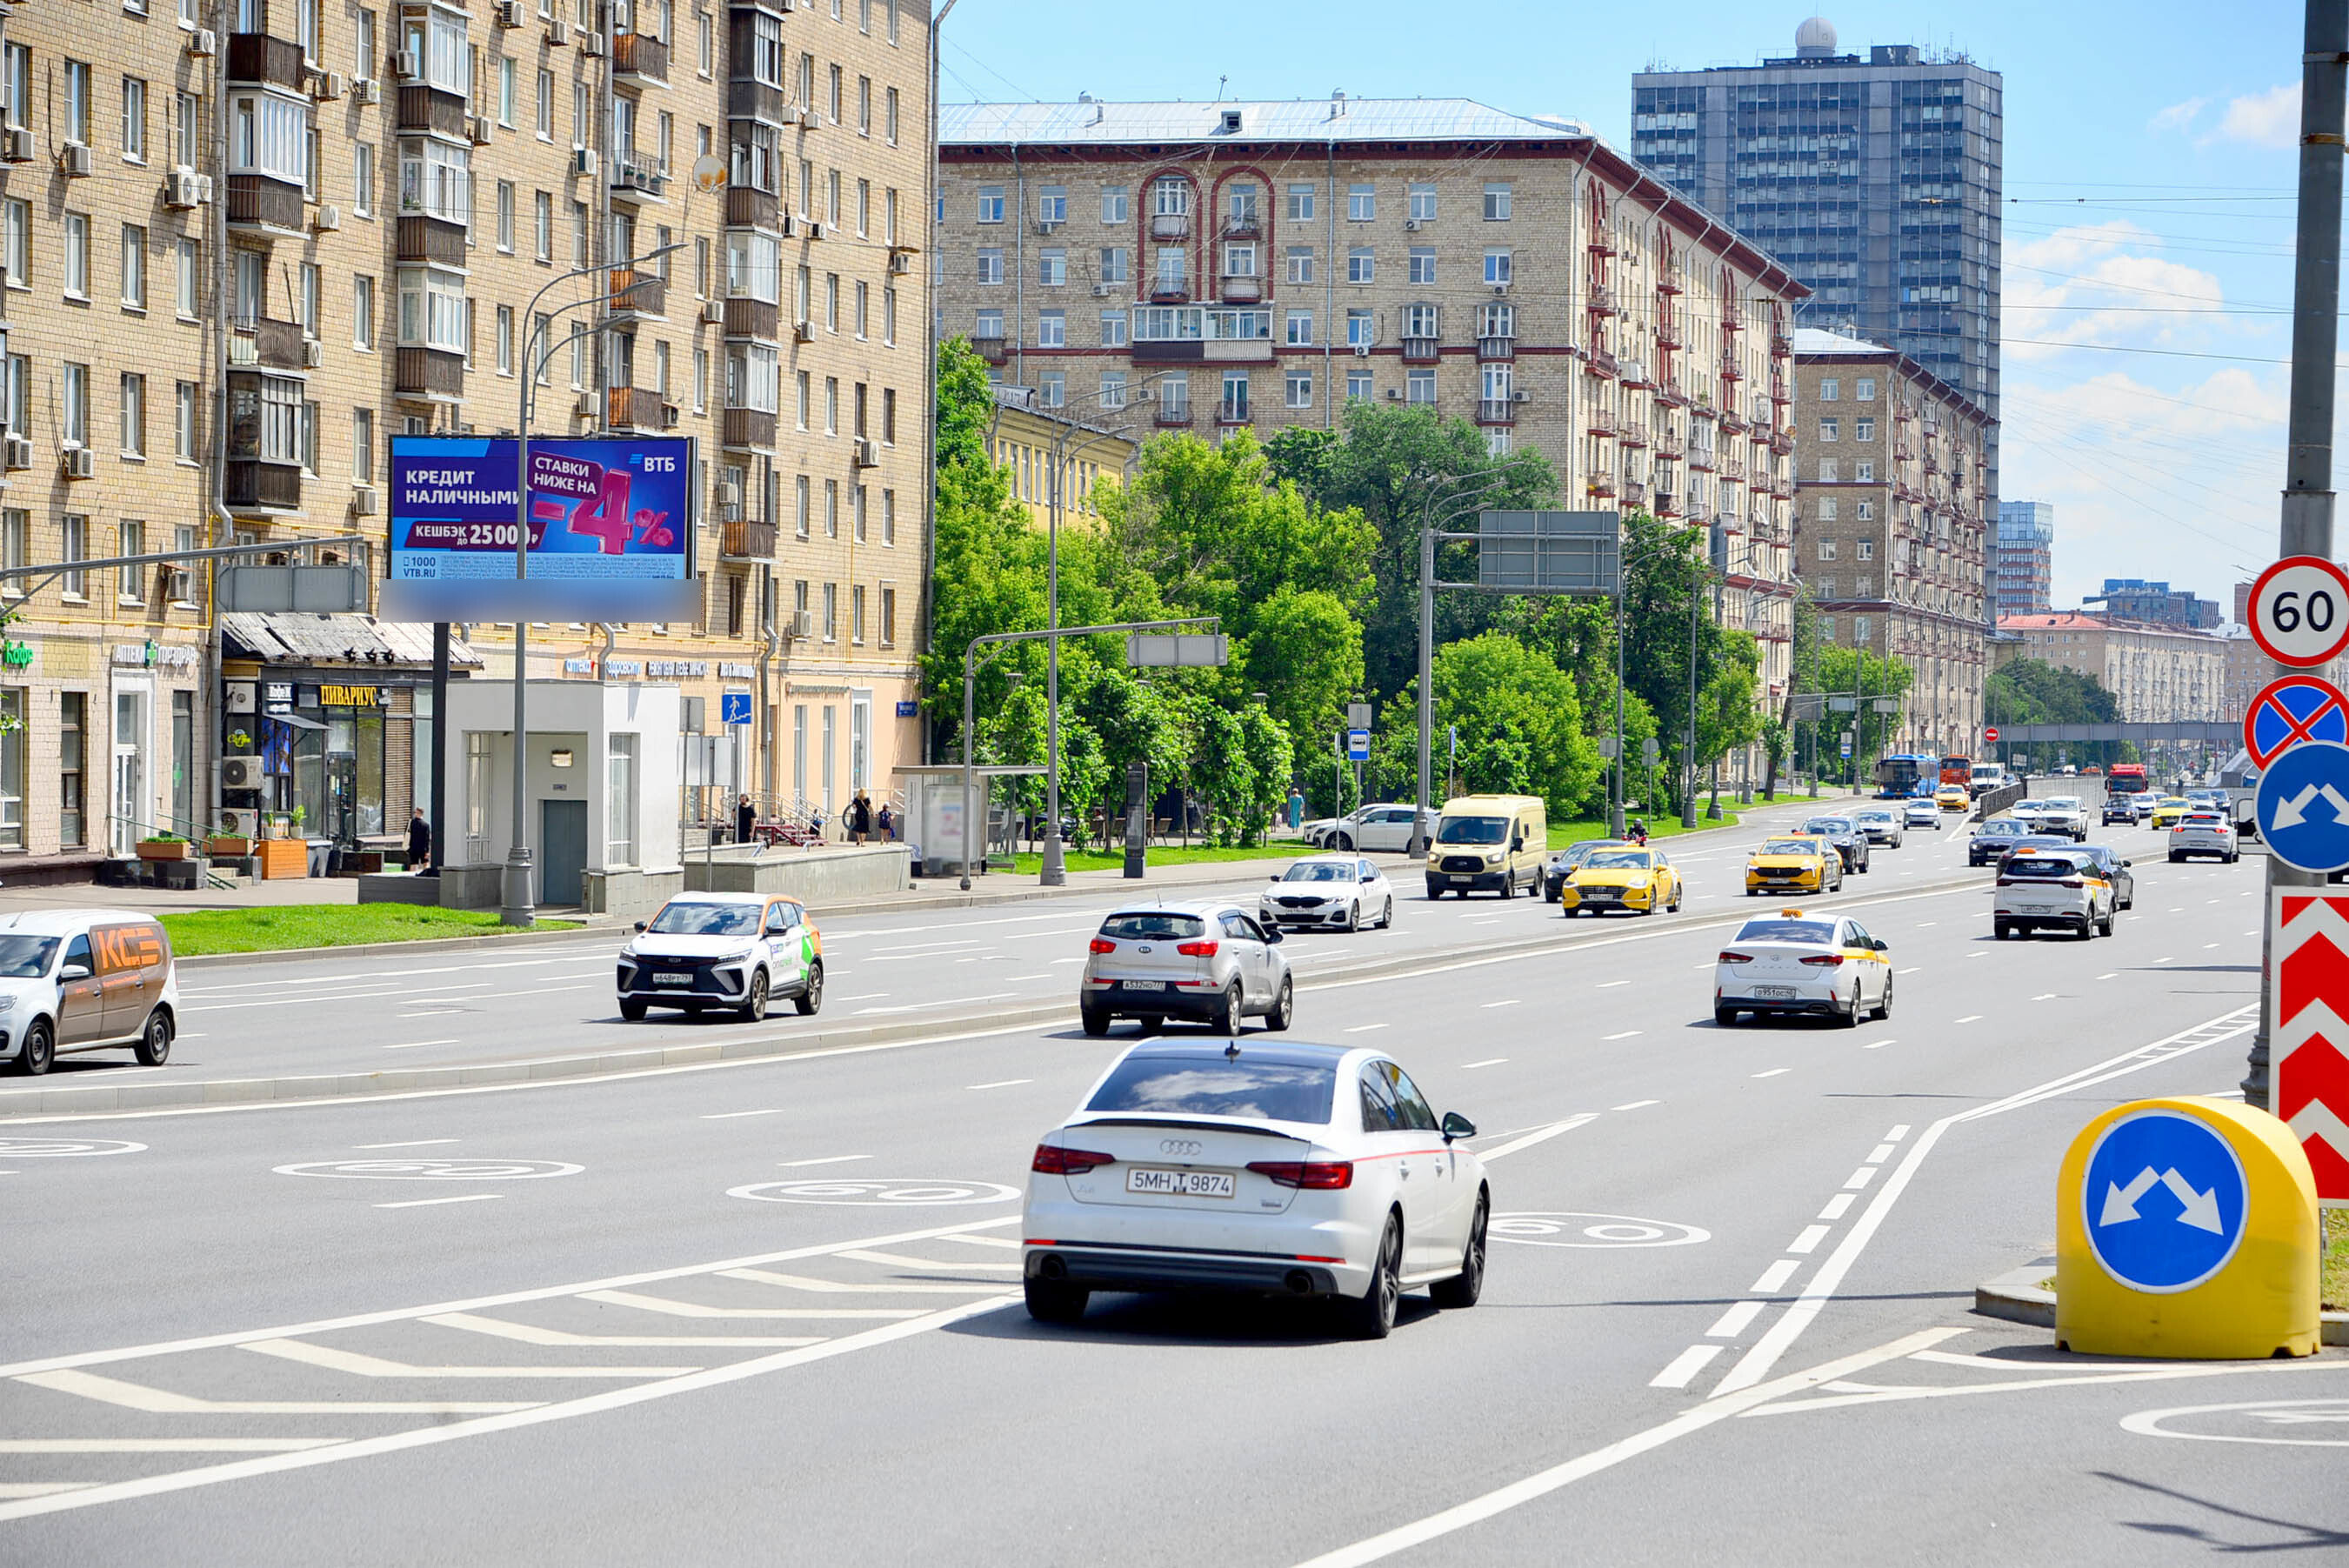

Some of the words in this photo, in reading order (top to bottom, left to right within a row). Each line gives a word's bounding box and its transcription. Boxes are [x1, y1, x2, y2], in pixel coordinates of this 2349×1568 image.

[535, 457, 590, 477] СТАВКИ
[644, 457, 676, 472] ВТБ
[406, 470, 475, 486] КРЕДИТ
[534, 472, 575, 490] НИЖЕ
[577, 480, 597, 494] НА
[416, 525, 467, 537] КЕШБЭК
[412, 557, 436, 567] 1000
[404, 568, 436, 578] VTB.RU
[2272, 590, 2334, 633] 60
[320, 685, 377, 706] ПИВАРИУС
